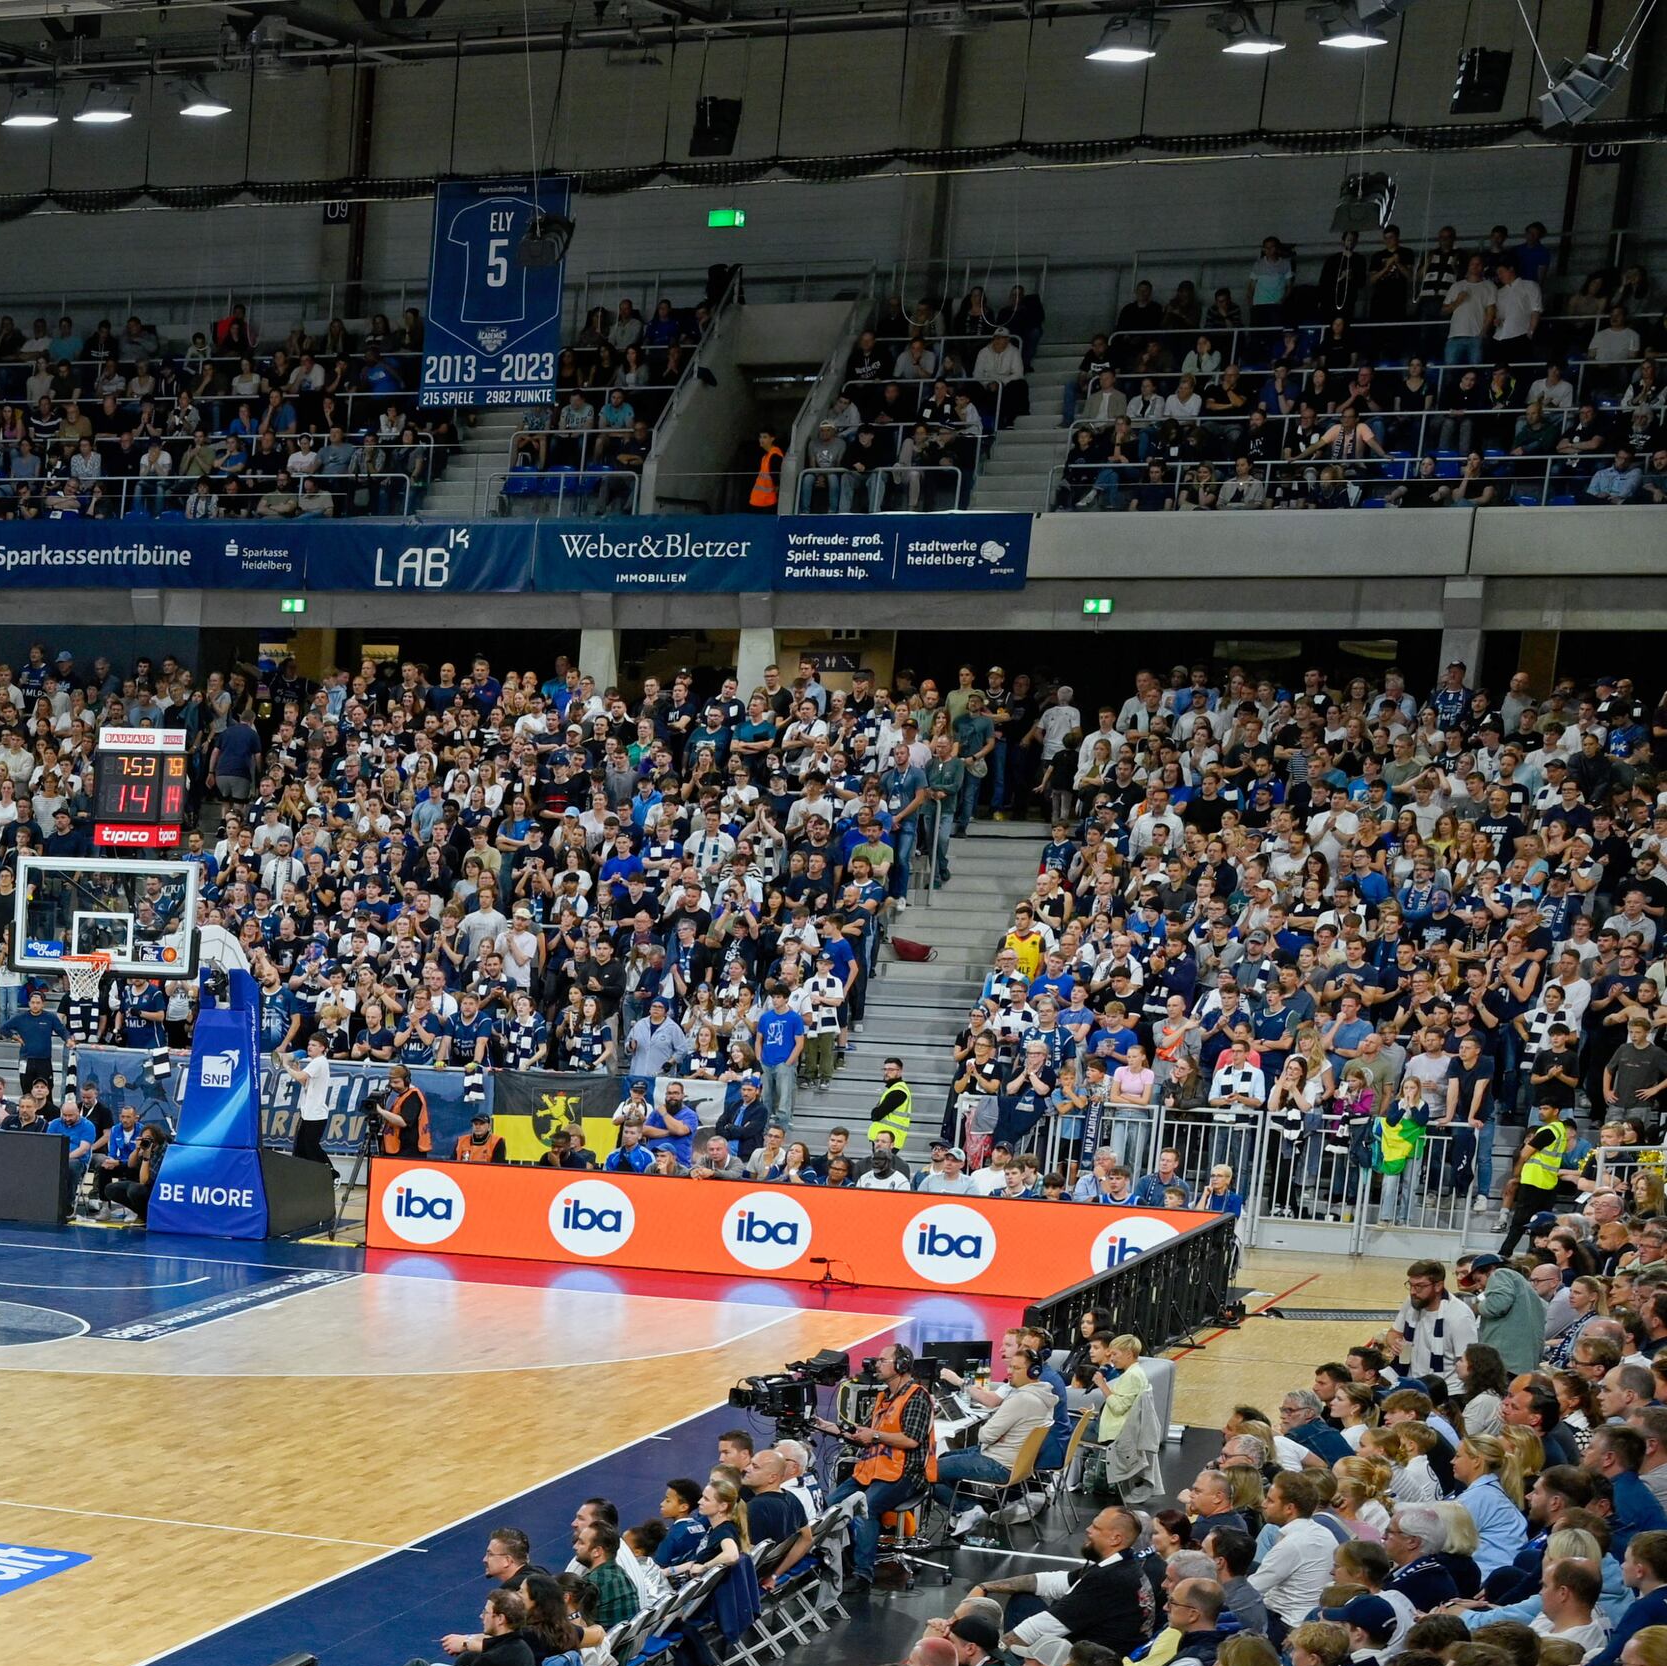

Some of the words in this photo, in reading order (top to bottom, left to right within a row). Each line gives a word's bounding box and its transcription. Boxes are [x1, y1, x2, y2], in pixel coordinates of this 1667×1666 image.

[490, 211, 515, 233] ELY
[486, 238, 509, 287] 5
[424, 354, 477, 384] 2013
[500, 352, 555, 382] 2023
[423, 392, 440, 405] 215
[442, 391, 474, 405] SPIELE
[486, 390, 512, 404] 2982
[514, 389, 552, 403] PUNKTE
[559, 532, 752, 560] Weber&Bletzer
[788, 533, 849, 547] Vorfreude:
[851, 533, 884, 549] groß.
[907, 539, 977, 553] stadtwerke
[242, 547, 289, 560] Sparkasse
[787, 549, 820, 564] Spiel:
[823, 550, 884, 565] spannend.
[906, 552, 976, 567] heidelberg
[242, 559, 292, 572] Heidelberg
[375, 546, 449, 588] LAB
[784, 565, 844, 580] Parkhaus:
[846, 566, 869, 581] hip.
[616, 572, 687, 584] IMMOBILIEN
[104, 732, 156, 745] BAUHAUS
[117, 784, 151, 814] 14
[101, 826, 150, 844] tipico
[142, 950, 158, 962] BBL
[201, 1072, 231, 1088] SNP
[158, 1182, 187, 1203] BE
[191, 1185, 254, 1209] MORE
[395, 1186, 453, 1221] iba
[563, 1198, 622, 1233] iba
[737, 1209, 799, 1246] iba
[918, 1223, 982, 1260] iba
[1107, 1236, 1145, 1269] ib
